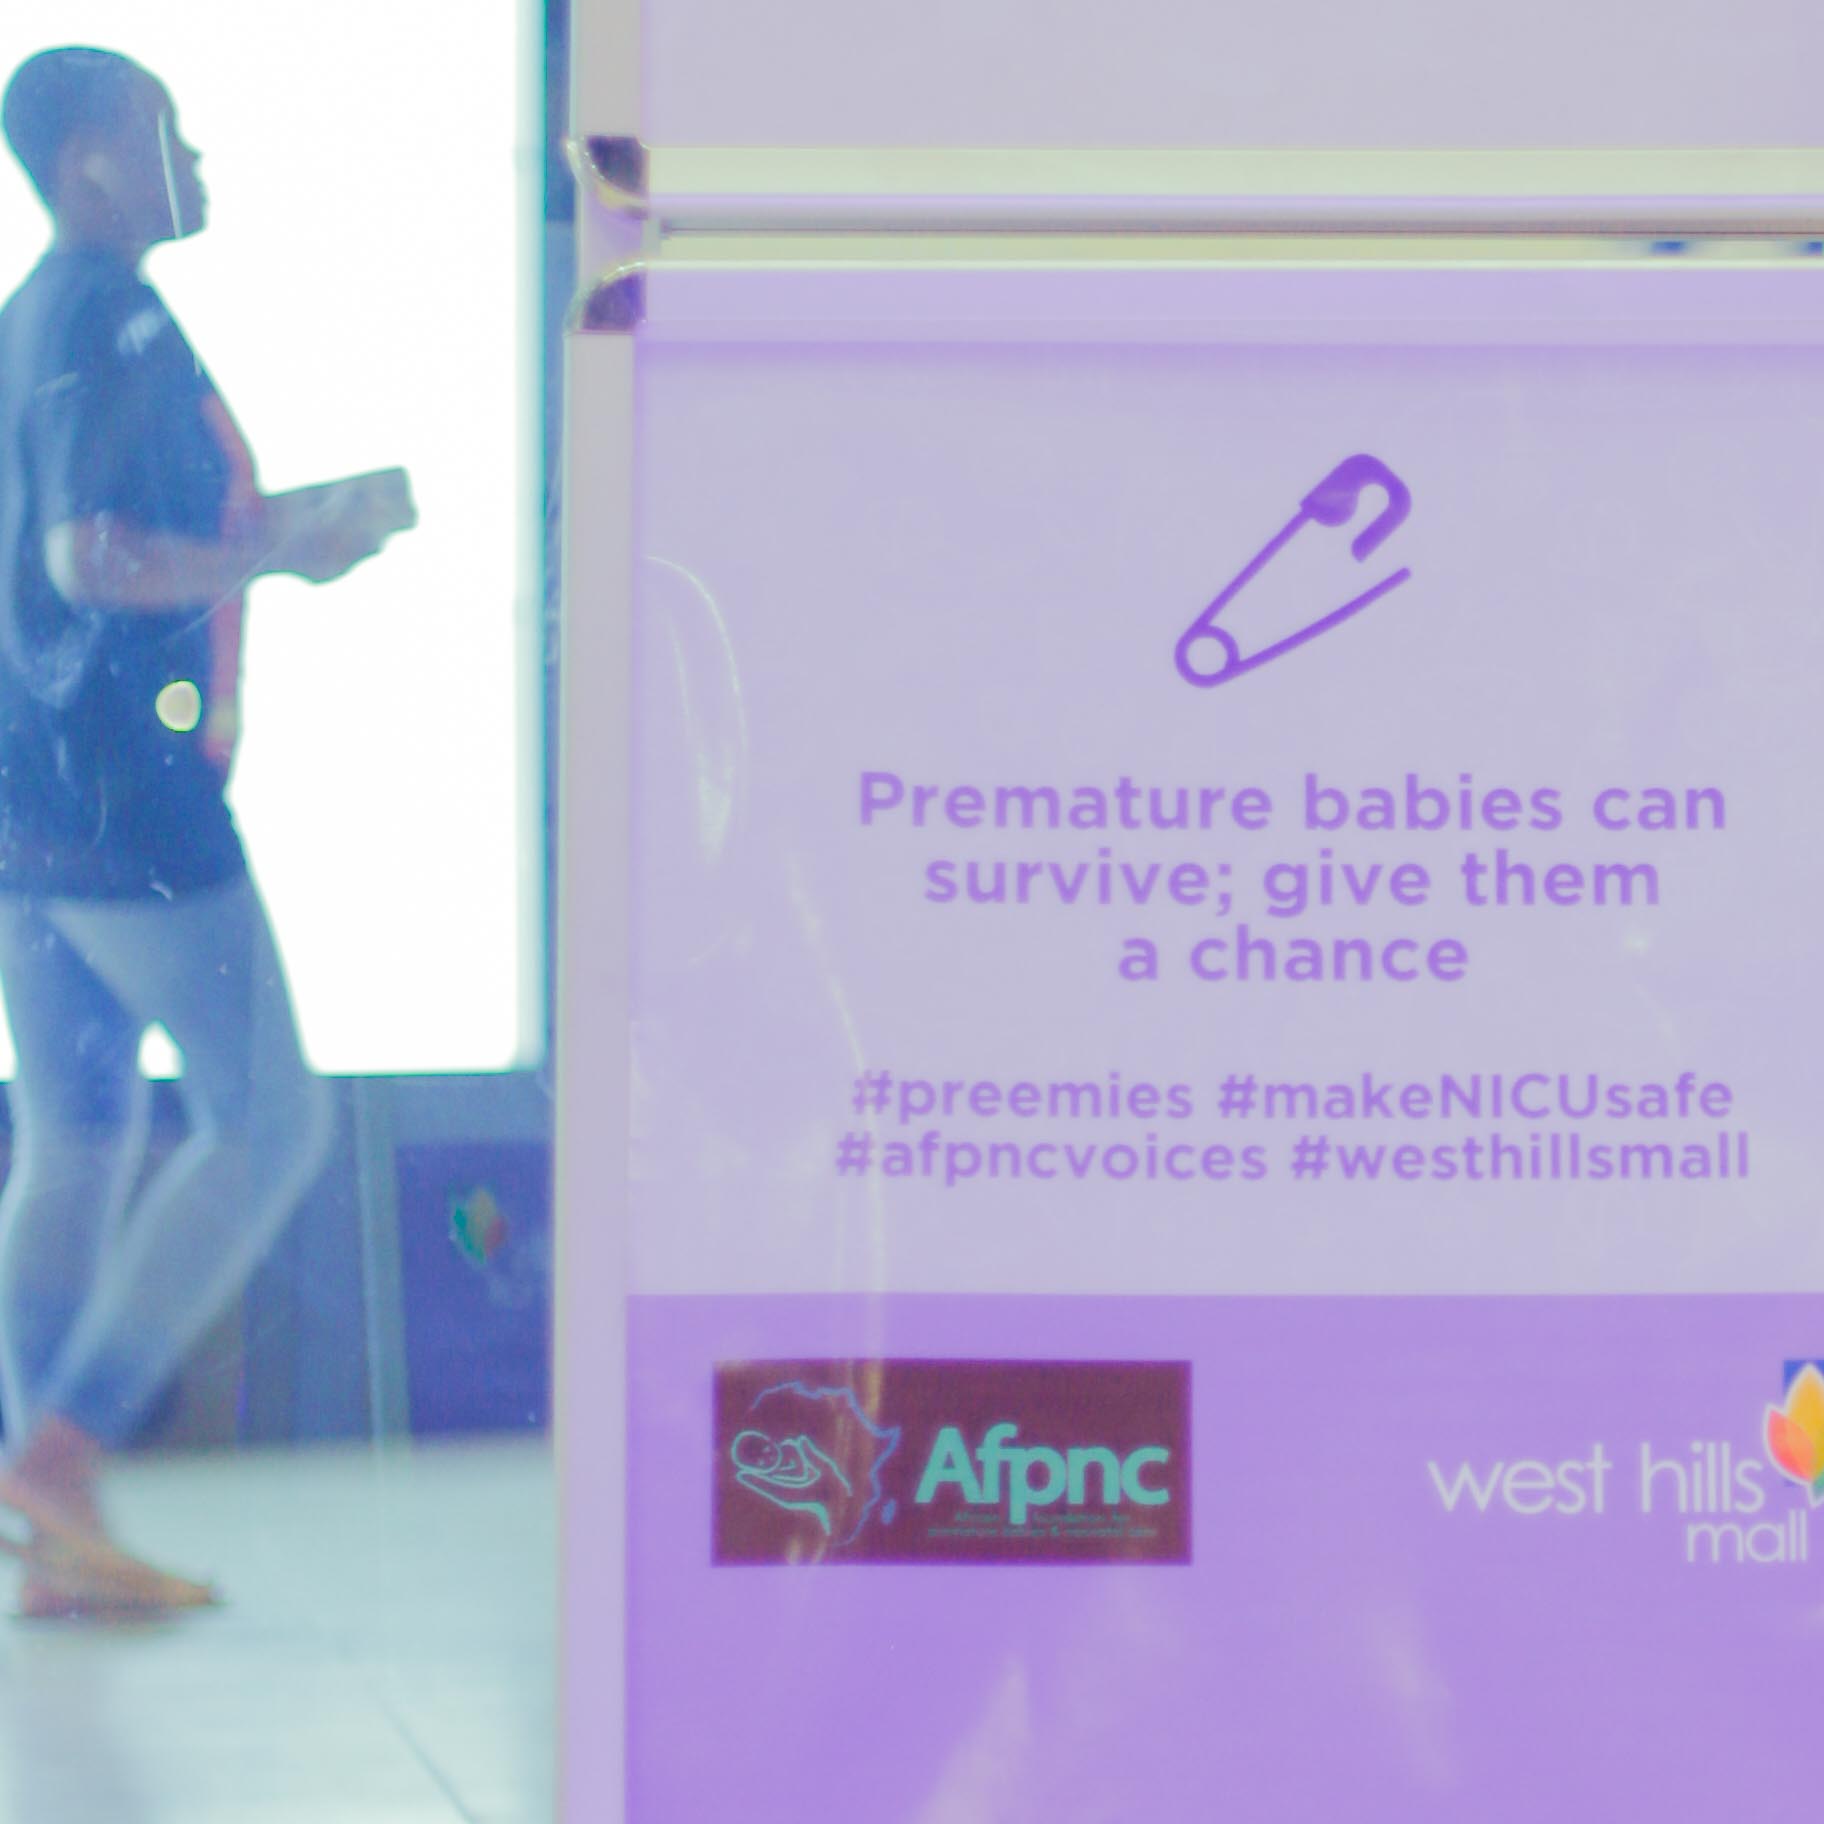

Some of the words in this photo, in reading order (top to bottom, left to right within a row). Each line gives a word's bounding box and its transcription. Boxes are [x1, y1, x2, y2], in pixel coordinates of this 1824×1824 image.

[858, 771, 1273, 831] Premature
[1304, 772, 1563, 831] babies
[1592, 786, 1726, 830] can
[923, 847, 1232, 916] survive;
[1262, 847, 1431, 918] give
[1460, 847, 1659, 906] them
[1117, 937, 1158, 981] a
[1189, 923, 1469, 982] chance
[852, 1070, 1193, 1125] #preemies
[1217, 1071, 1733, 1119] #makeNICUsafe
[835, 1130, 1268, 1187] #afpncvoices
[1290, 1131, 1749, 1180] #westhillsmall
[914, 1422, 1170, 1525] Afpnc
[1427, 1442, 1613, 1515] west
[1640, 1440, 1766, 1514] hills
[1686, 1508, 1808, 1563] mall
